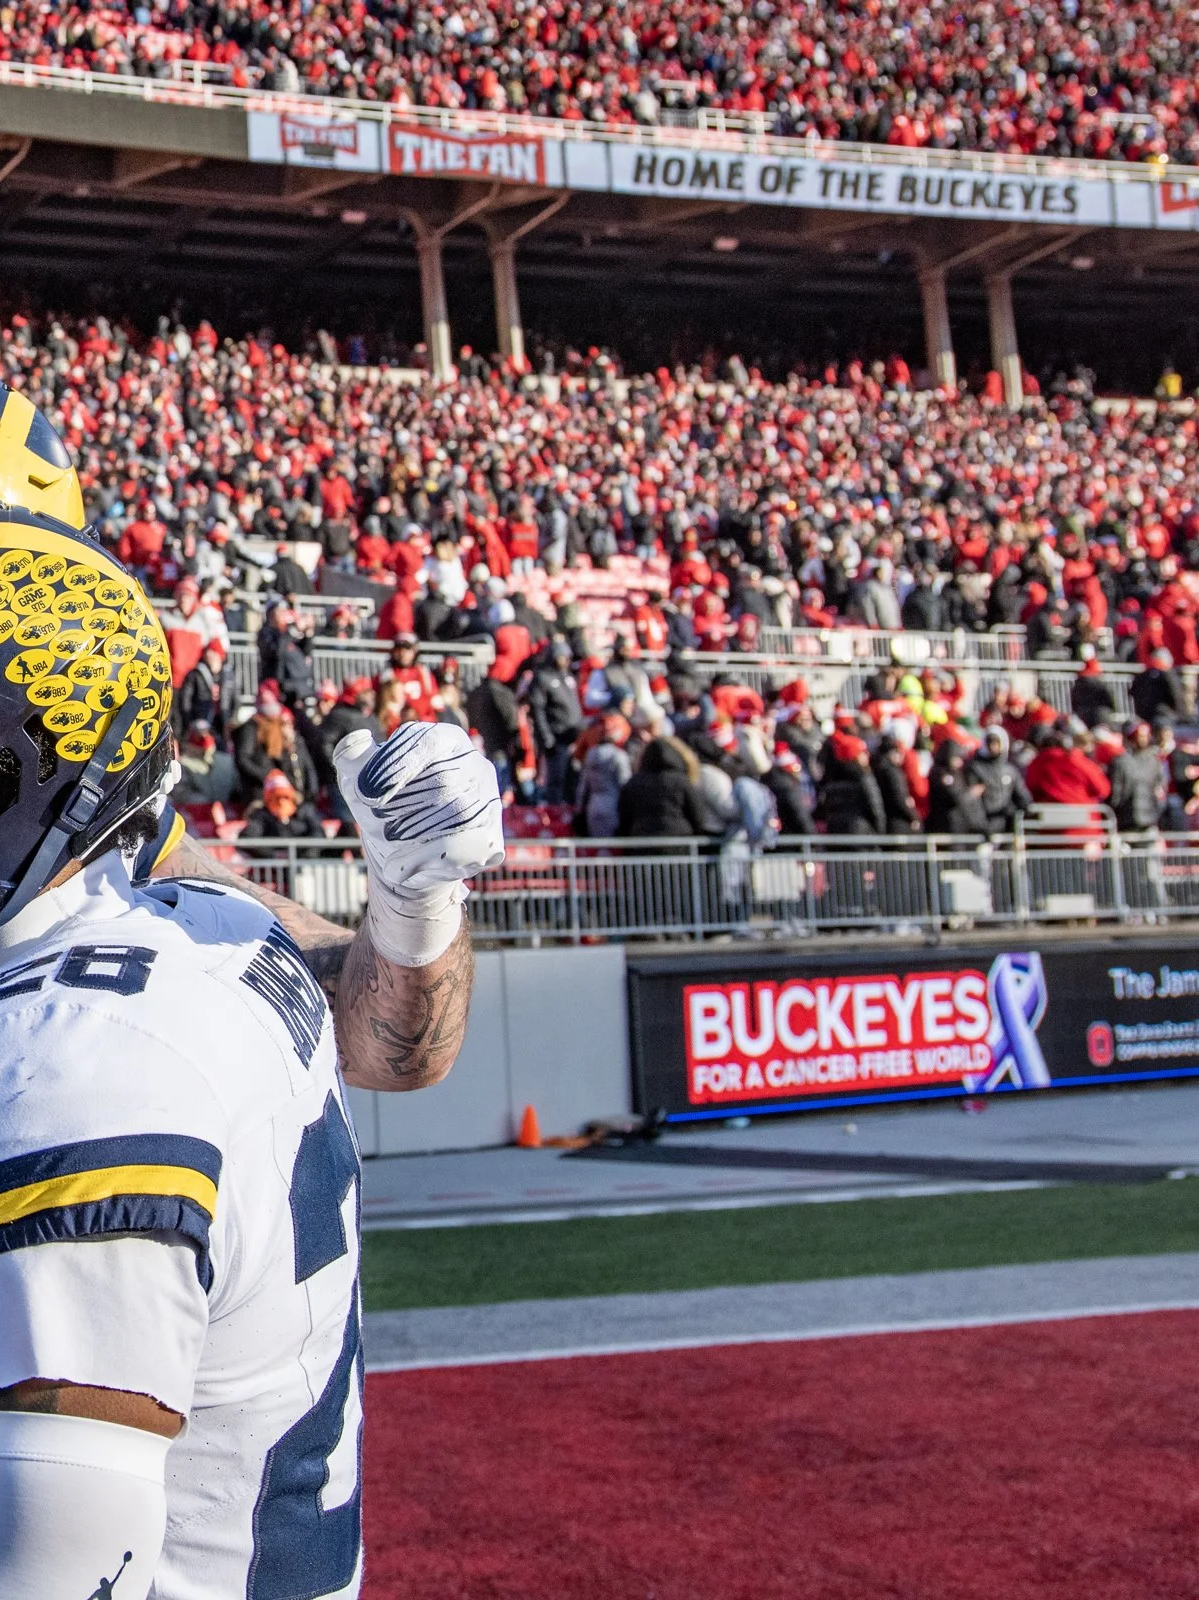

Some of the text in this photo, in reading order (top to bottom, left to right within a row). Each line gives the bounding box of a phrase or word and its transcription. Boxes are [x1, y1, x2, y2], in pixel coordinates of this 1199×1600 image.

[633, 153, 1078, 214] HOME OF THE BUCKEYES
[17, 556, 31, 569] 970
[18, 588, 47, 607] GAME
[22, 587, 34, 595] THE
[31, 601, 47, 613] 975
[76, 601, 90, 612] 974
[41, 622, 56, 636] 979
[32, 660, 48, 674] 984
[92, 666, 105, 678] 977
[52, 686, 67, 698] 983
[69, 712, 85, 725] 982
[1107, 966, 1155, 1000] The
[689, 975, 990, 1060] BUCKEYES
[693, 1043, 992, 1094] FOR A CANCER-FREE WORLD
